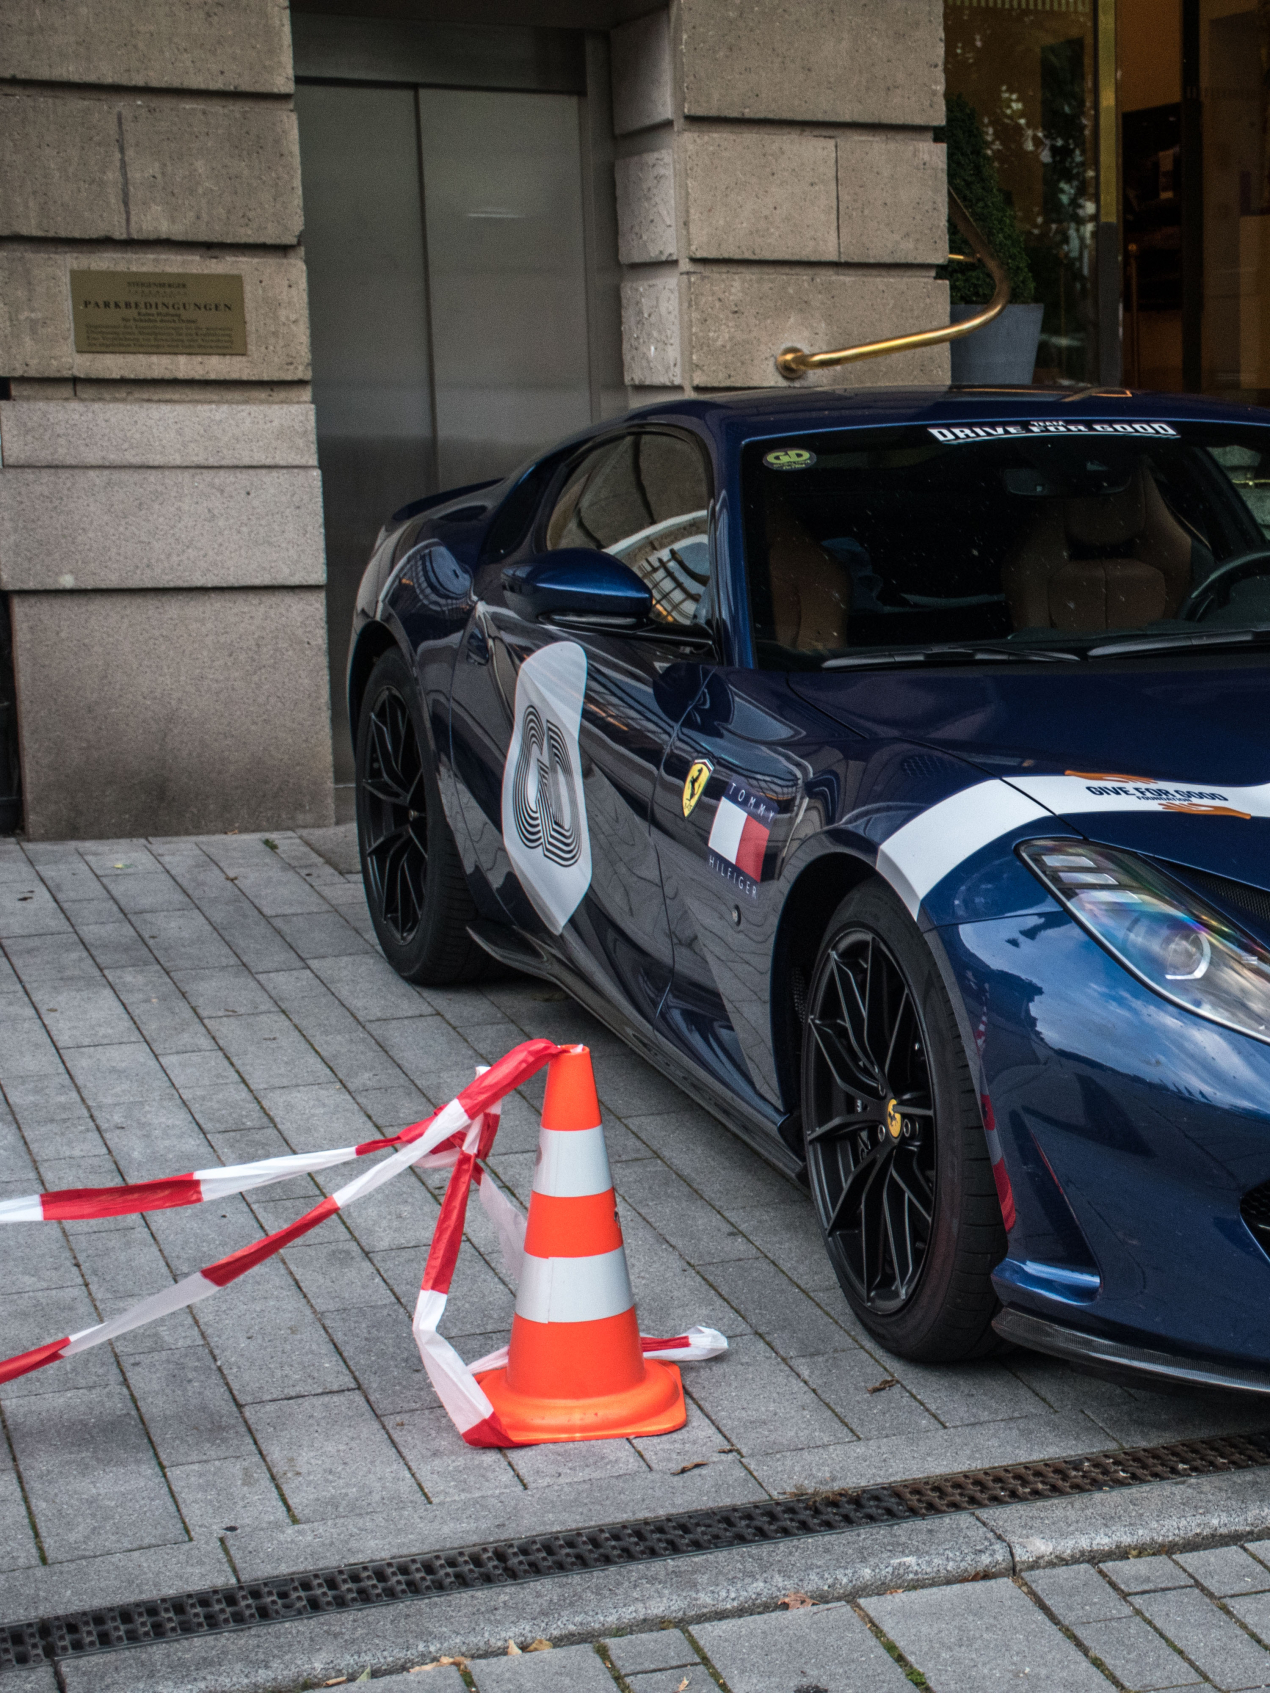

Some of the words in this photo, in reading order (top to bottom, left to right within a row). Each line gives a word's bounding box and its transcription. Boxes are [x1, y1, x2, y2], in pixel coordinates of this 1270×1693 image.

[82, 300, 233, 311] PARKBEDINGUNGEN
[927, 425, 1026, 442] DRIVE
[1028, 424, 1089, 433] FOR
[1092, 422, 1179, 436] GOOD
[766, 450, 811, 464] GD
[1085, 786, 1136, 796] GIVE
[1133, 787, 1176, 798] FOR
[1173, 789, 1230, 802] GOOD
[1136, 795, 1194, 803] FOUNDATION
[728, 782, 775, 823] TOMMY
[708, 854, 757, 900] HILFIGER
